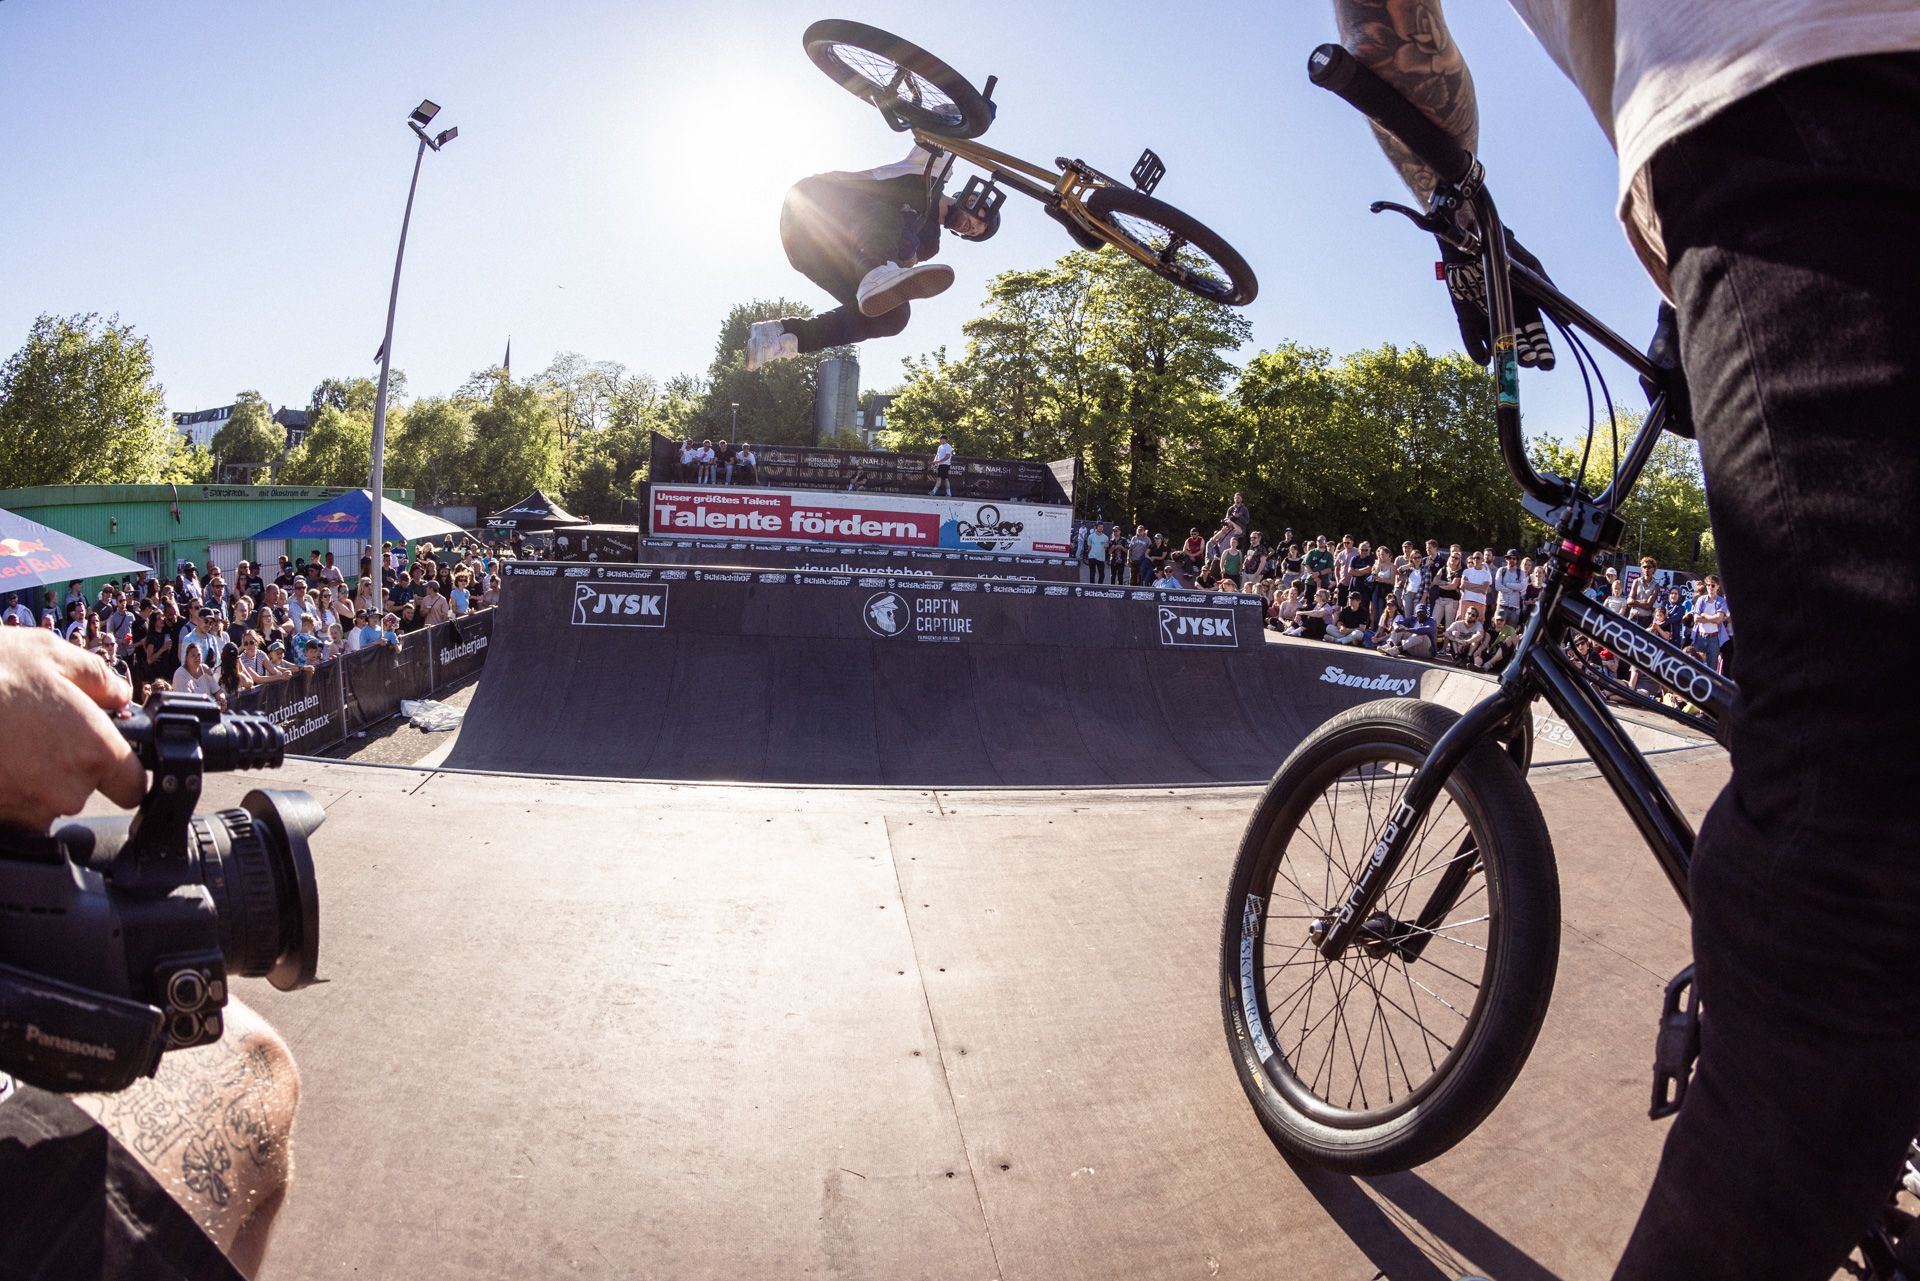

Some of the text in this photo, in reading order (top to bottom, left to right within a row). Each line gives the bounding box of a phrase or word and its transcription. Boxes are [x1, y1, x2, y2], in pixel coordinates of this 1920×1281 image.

[657, 493, 781, 506] Unser größtes Talent:
[509, 507, 548, 515] XLC
[655, 504, 926, 538] Talente fördern.
[300, 524, 358, 533] Red Bull
[487, 519, 517, 527] XLC
[27, 553, 72, 572] Bull
[592, 594, 662, 616] JYSK
[916, 598, 959, 614] CAPT'N
[916, 617, 973, 633] CAPTURE
[1176, 616, 1232, 637] JYSK
[440, 635, 488, 665] #butcherjam
[1319, 665, 1416, 696] Sunday
[1241, 943, 1261, 1033] SKYLARK
[26, 1023, 117, 1061] Panasonic
